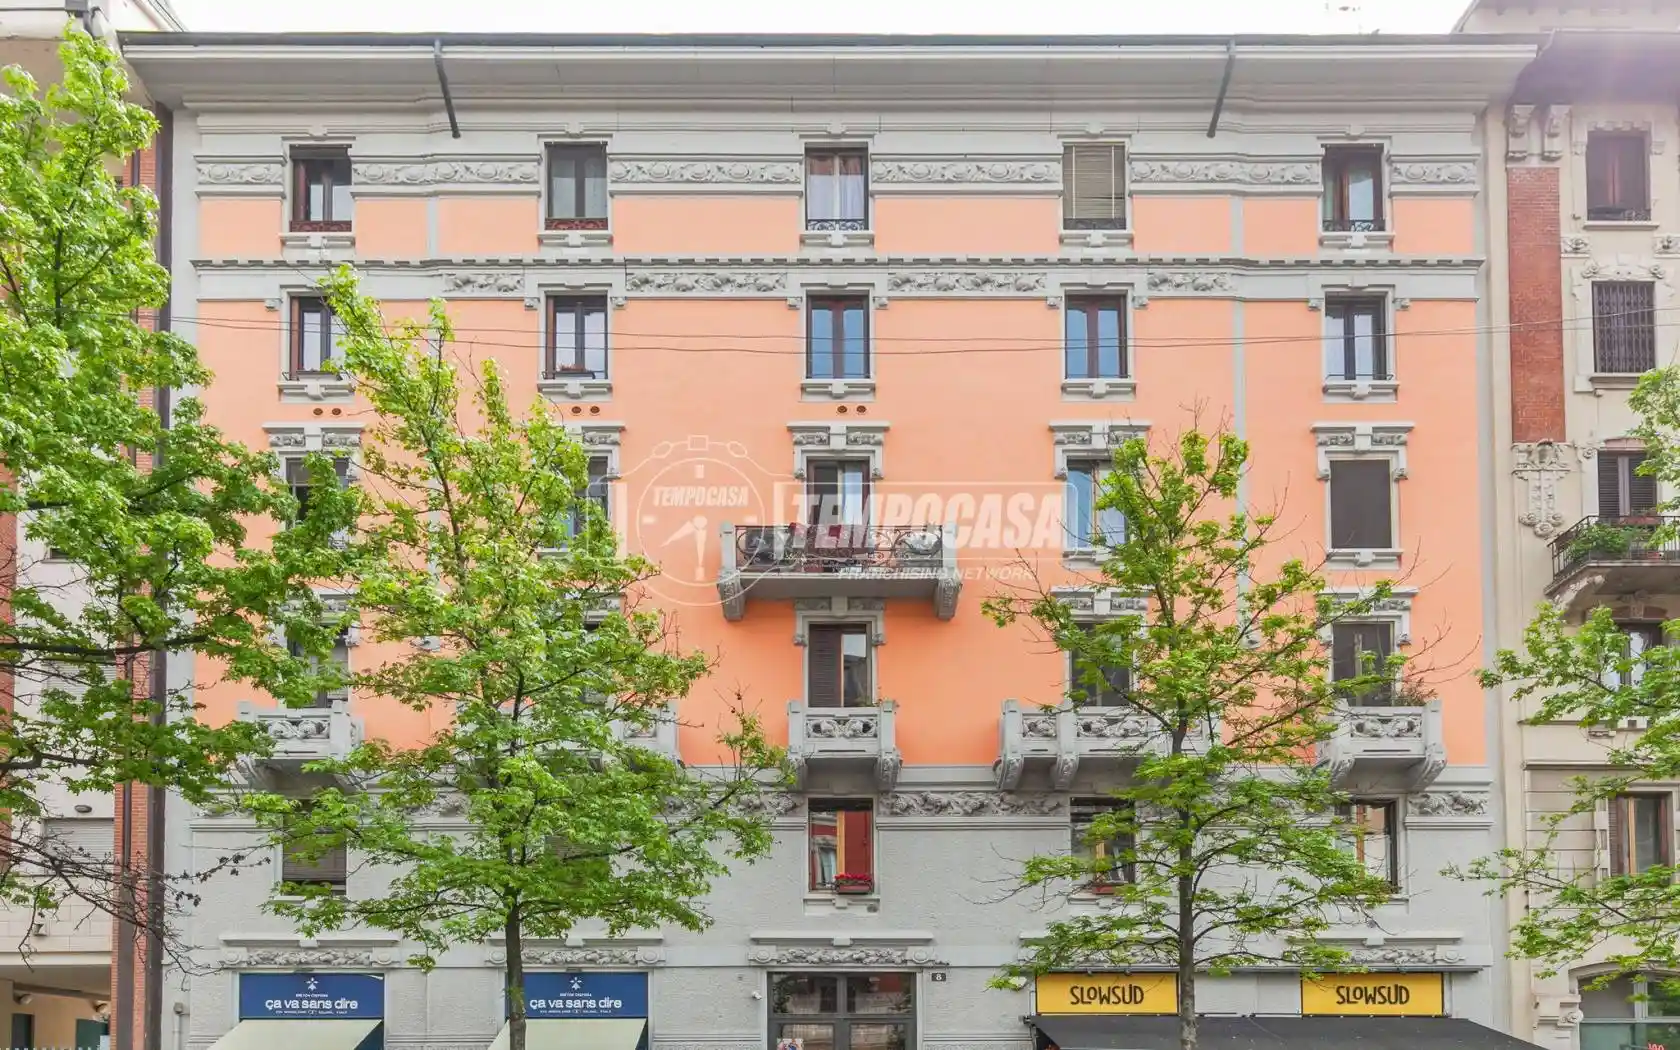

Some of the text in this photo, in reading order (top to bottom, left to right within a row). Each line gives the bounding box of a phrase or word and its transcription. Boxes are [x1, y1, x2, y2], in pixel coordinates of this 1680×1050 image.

[529, 996, 622, 1010] ça va sans dire
[1069, 983, 1145, 1005] SLOWSUD
[1336, 983, 1410, 1005] SLOWSUD
[265, 997, 358, 1011] ça va sans dire
